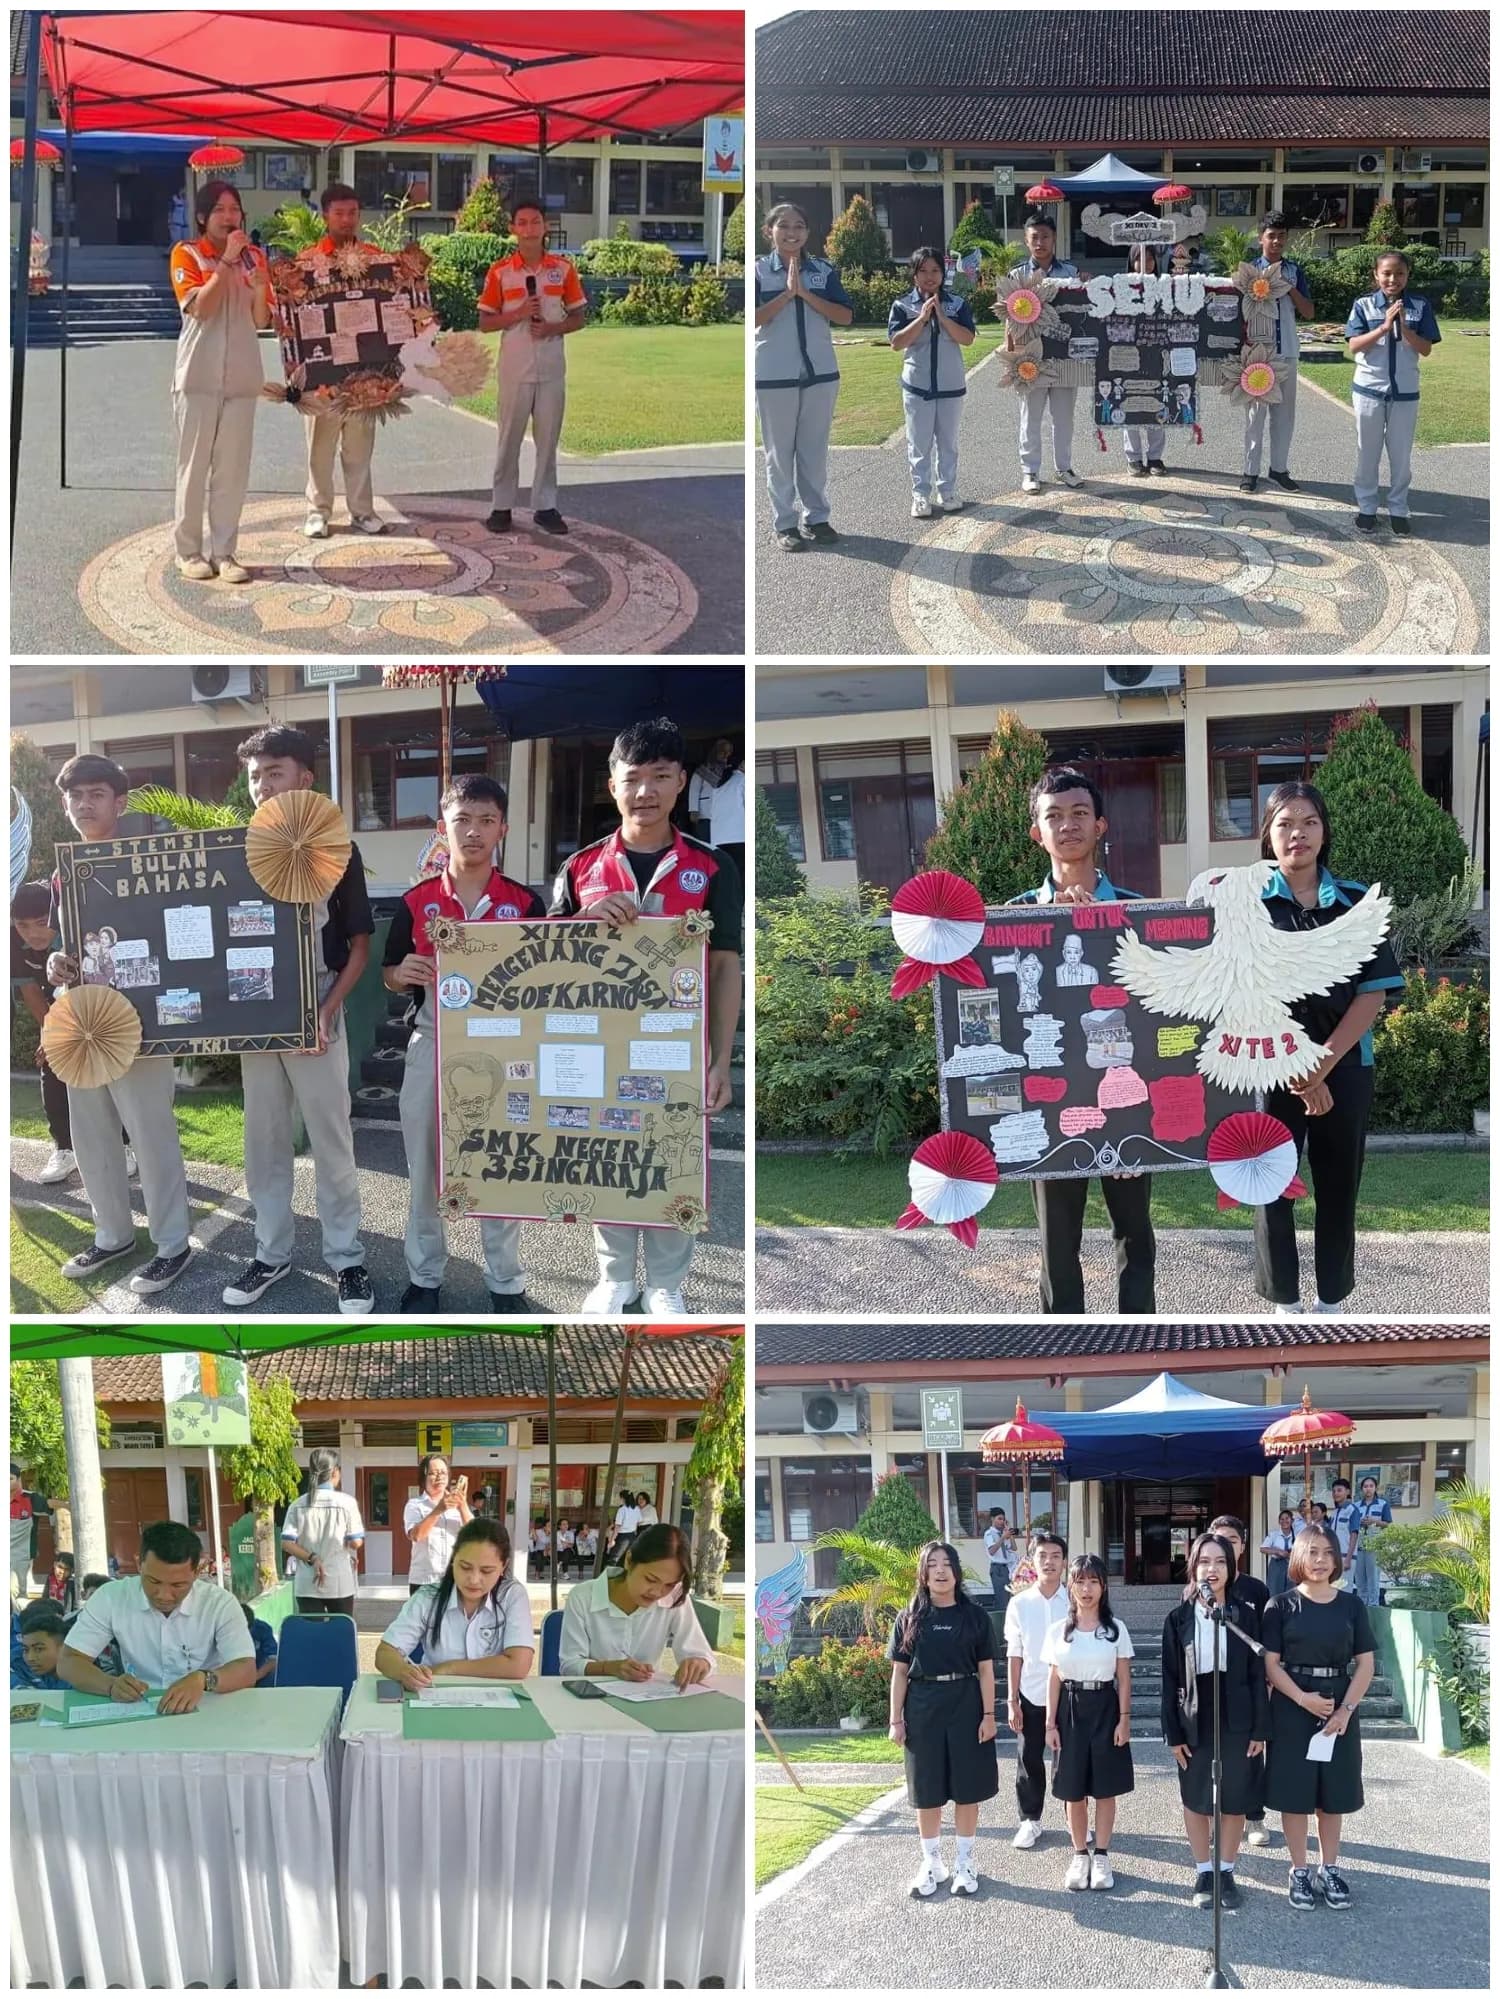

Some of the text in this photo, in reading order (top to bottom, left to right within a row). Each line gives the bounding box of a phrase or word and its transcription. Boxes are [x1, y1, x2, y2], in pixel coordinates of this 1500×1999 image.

[1087, 272, 1206, 318] SEMU
[112, 832, 205, 856] STEMSI
[131, 851, 207, 875] BULAN
[116, 869, 227, 897] BAHASA
[519, 923, 550, 941] XI
[555, 923, 598, 939] TKR
[982, 923, 1054, 948] BANGKIT
[1071, 904, 1134, 930] UNTUK
[472, 939, 611, 1011] MENGENANG
[499, 980, 637, 1011] SOEKARNO
[1218, 1033, 1242, 1057] XI
[1246, 1037, 1275, 1059] TE
[1281, 1033, 1298, 1056] 2
[459, 1129, 656, 1165] SMK NEGERI
[426, 1425, 442, 1452] E
